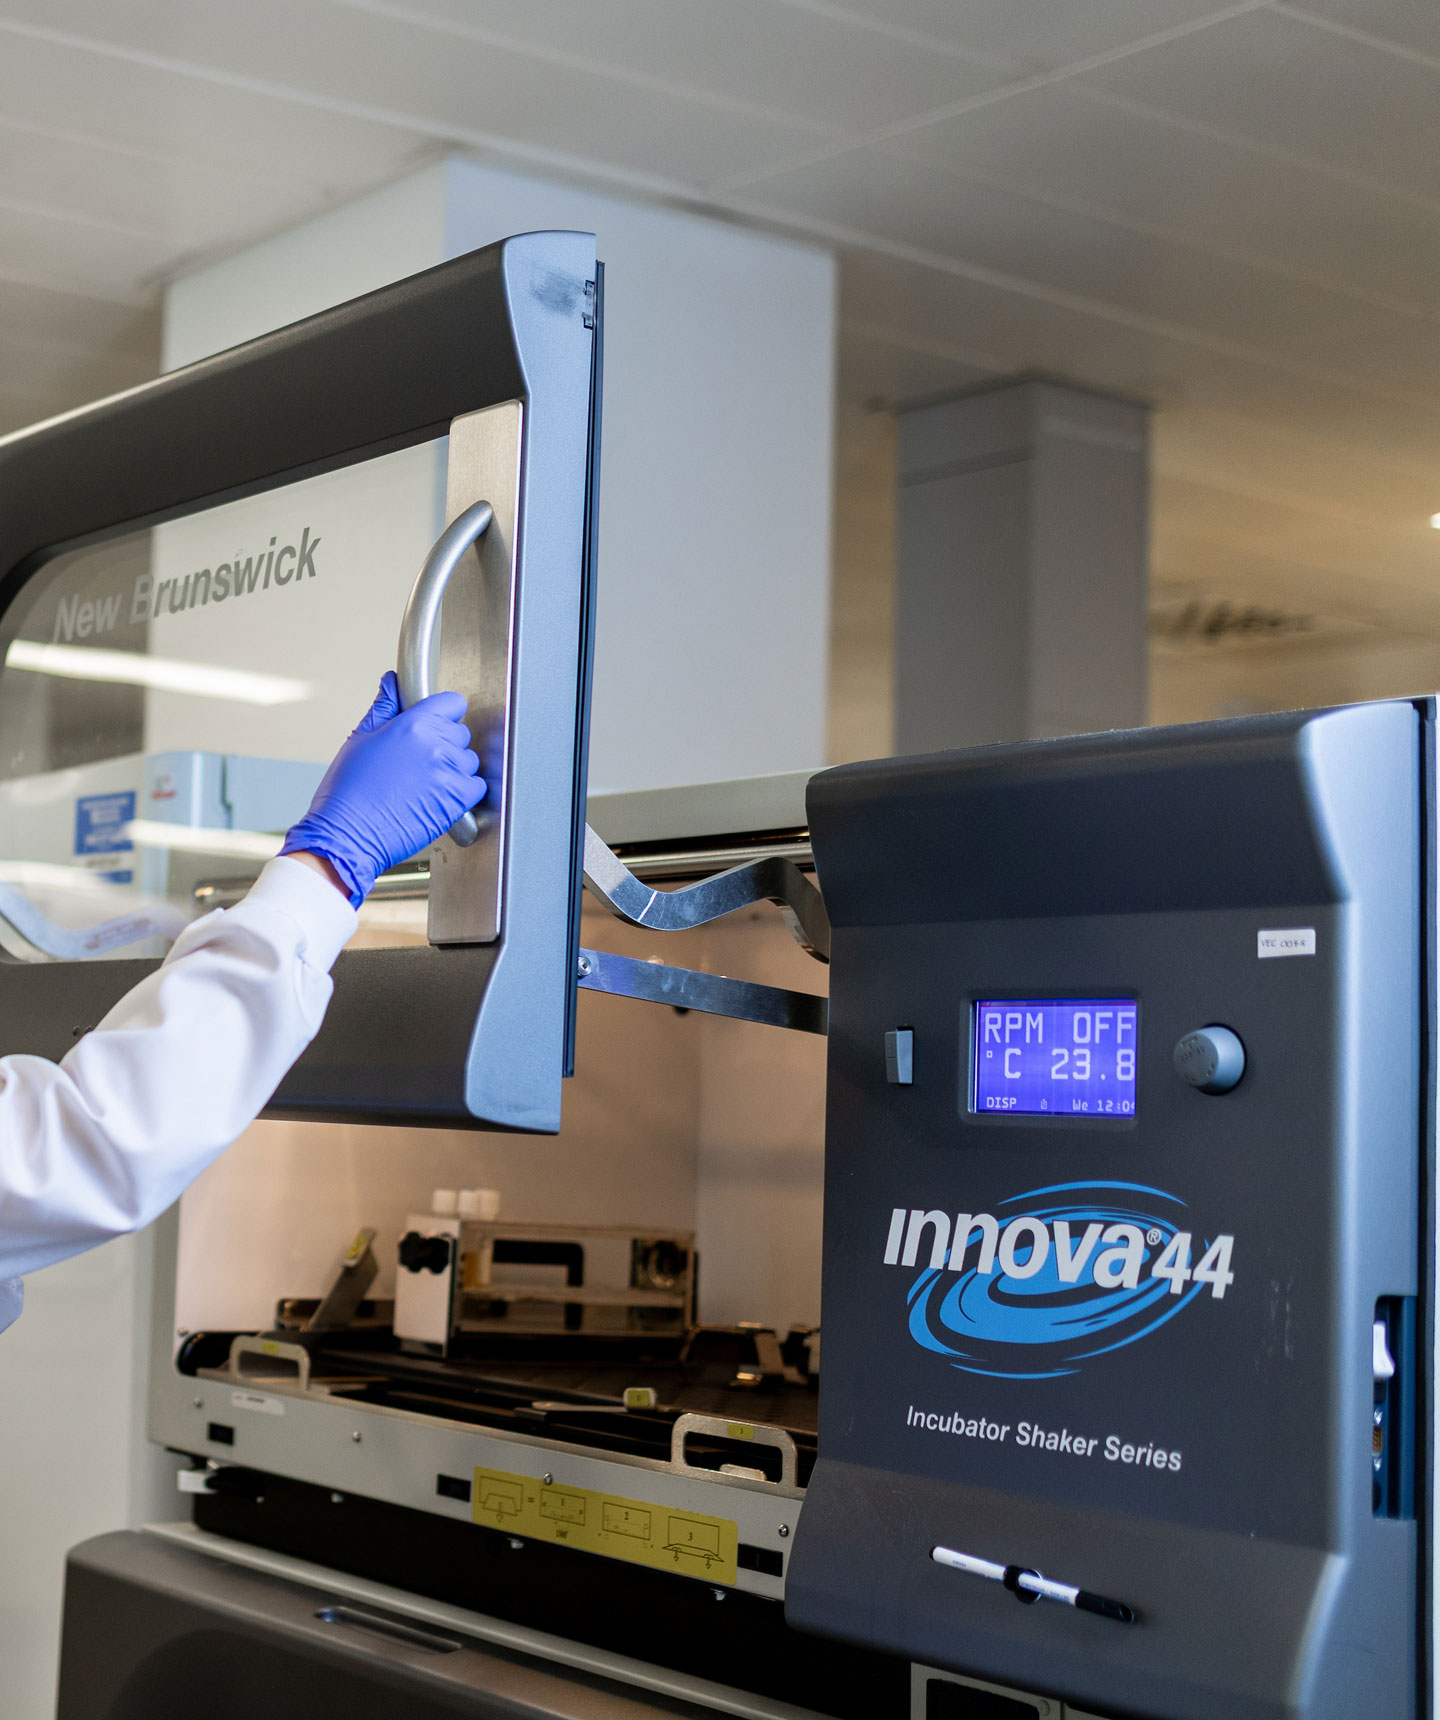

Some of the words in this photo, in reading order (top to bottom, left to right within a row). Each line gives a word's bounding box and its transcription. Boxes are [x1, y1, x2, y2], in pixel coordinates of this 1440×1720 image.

[53, 593, 122, 643] New
[130, 526, 322, 624] Brunswick
[984, 1012, 1043, 1044] RPM
[1073, 1012, 1135, 1044] OFF
[1051, 1048, 1135, 1081] 23.8
[986, 1096, 1017, 1109] DISP
[1072, 1098, 1089, 1111] We
[906, 1405, 1010, 1442] Incubator
[1015, 1420, 1098, 1457] Shaker
[1103, 1434, 1182, 1472] Series
[687, 1532, 694, 1542] 3
